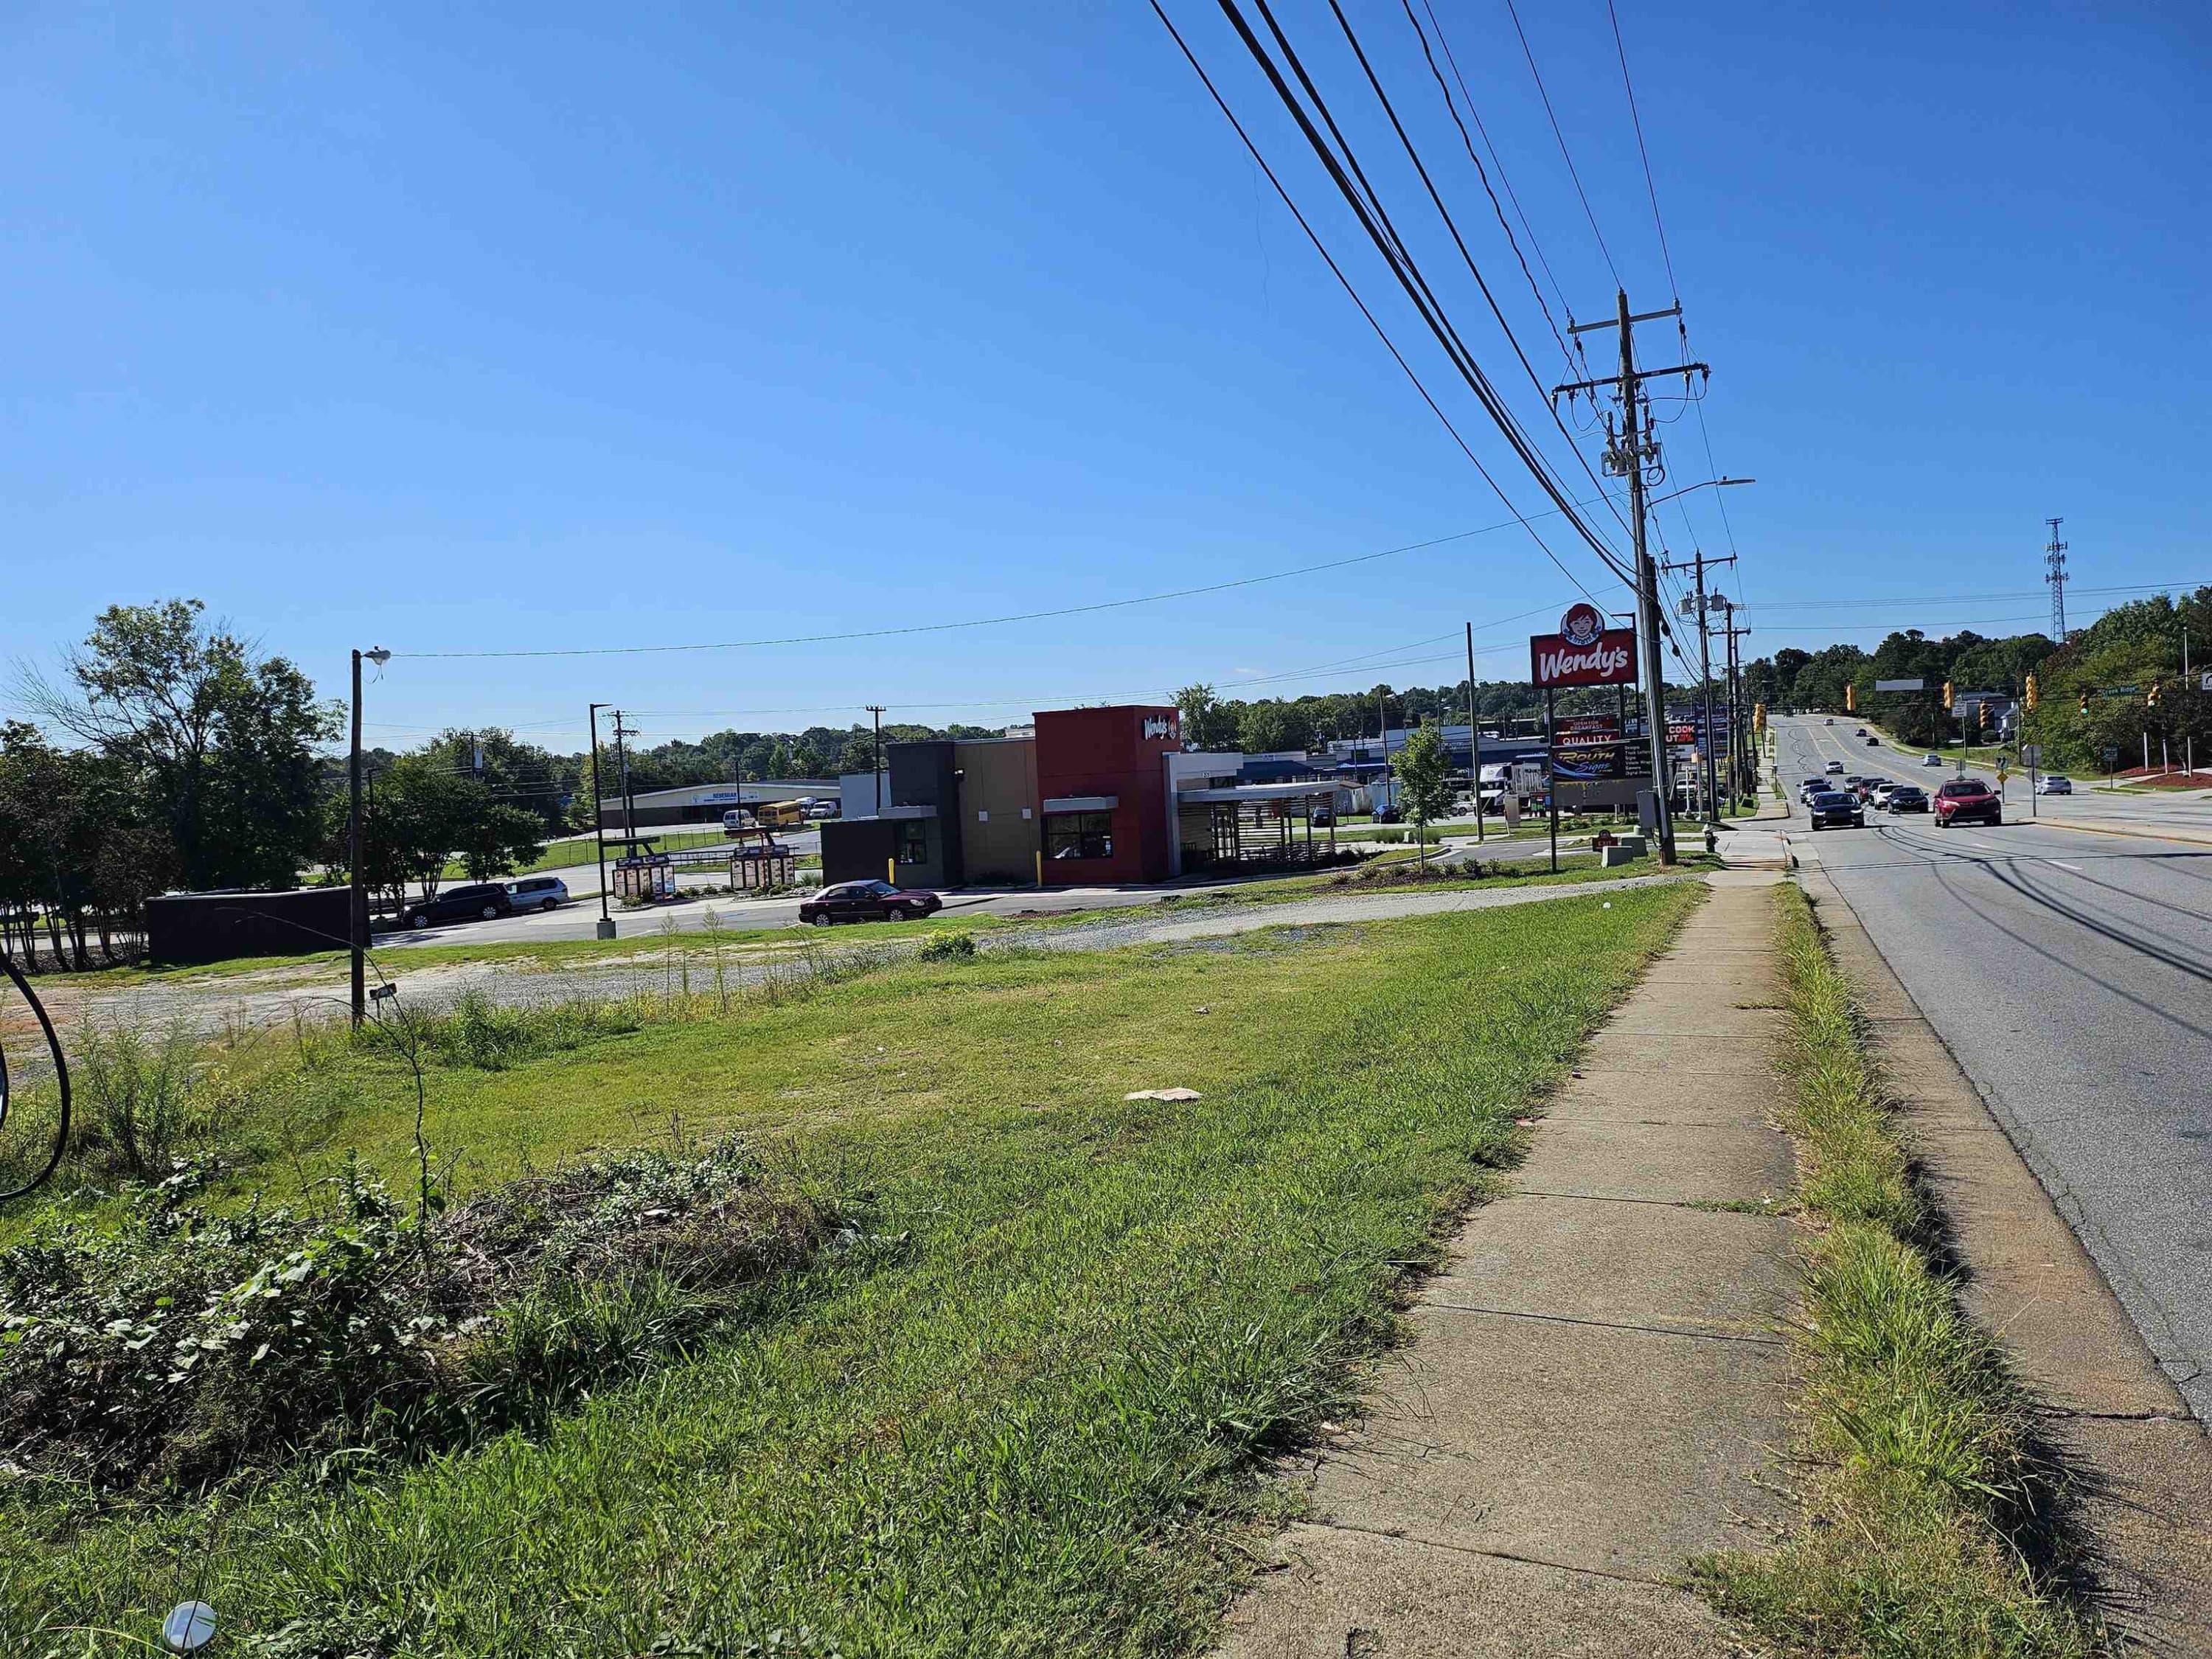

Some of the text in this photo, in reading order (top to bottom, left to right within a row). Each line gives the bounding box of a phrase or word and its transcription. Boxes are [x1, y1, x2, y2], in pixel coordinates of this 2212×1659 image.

[1540, 641, 1628, 681] Wendy's
[1144, 714, 1167, 740] Wendy's
[1669, 726, 1695, 734] COOK
[1562, 734, 1612, 745] QUALITY
[1666, 734, 1679, 742] UT
[1575, 761, 1611, 773] Signs
